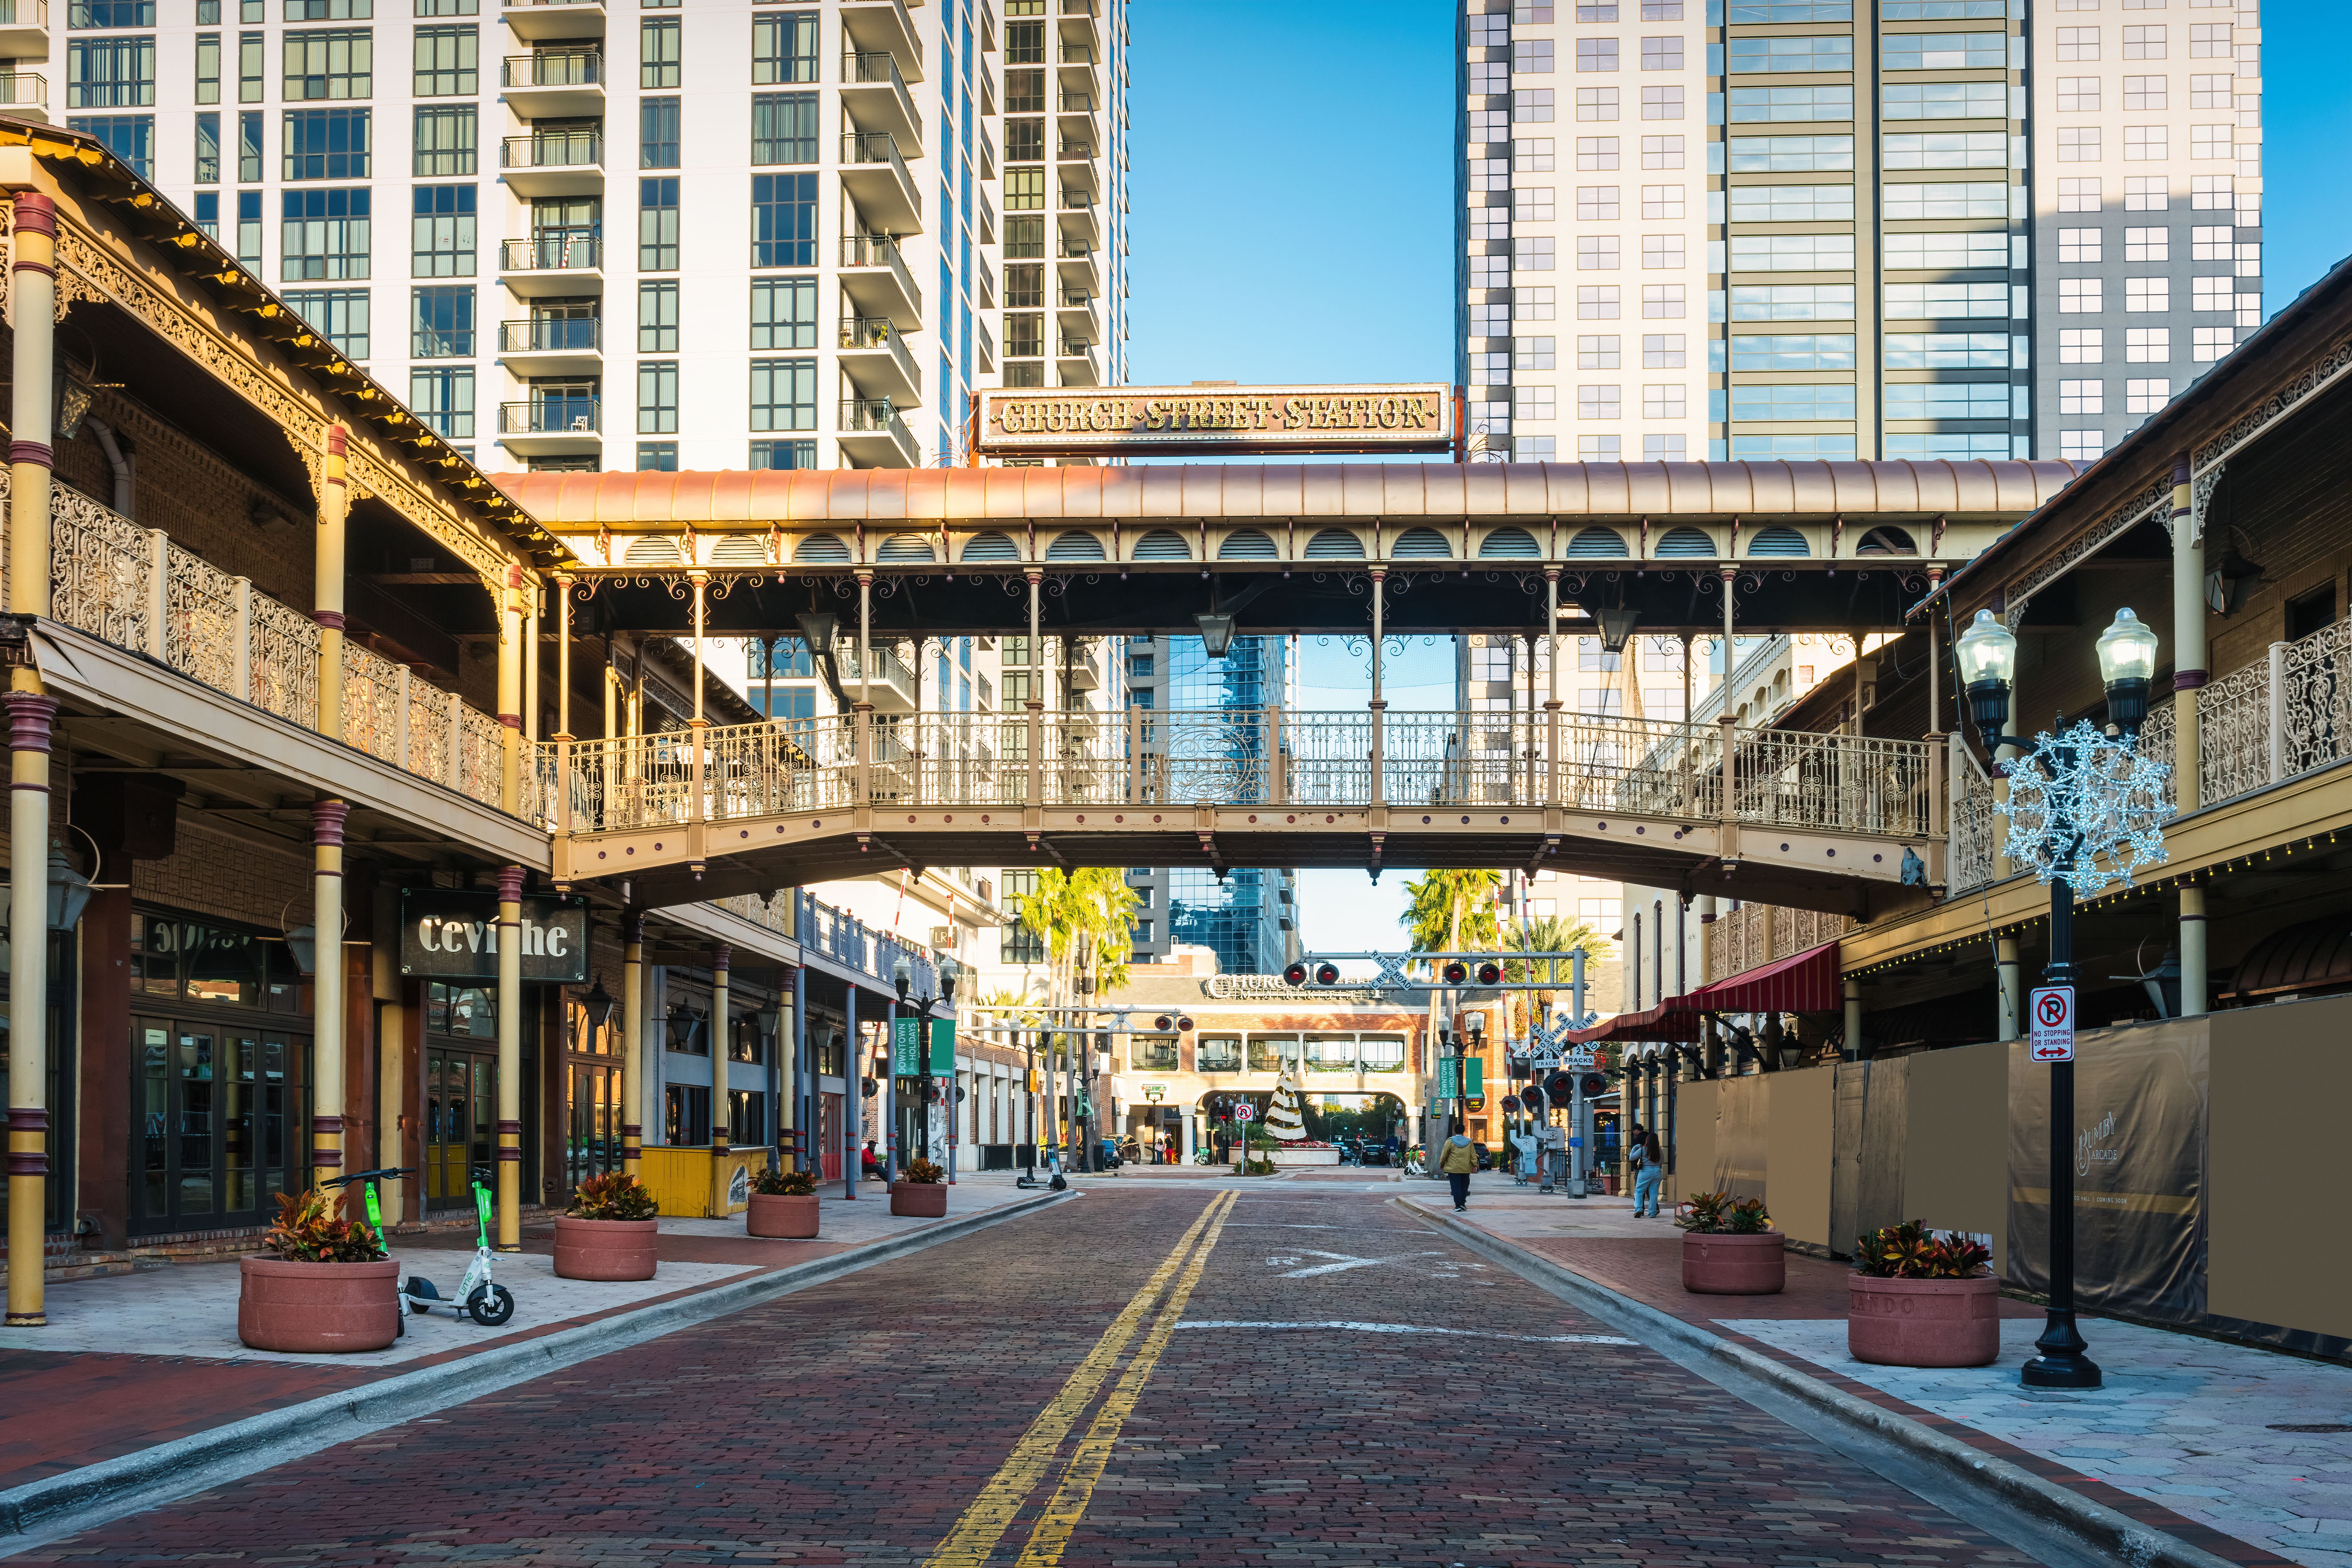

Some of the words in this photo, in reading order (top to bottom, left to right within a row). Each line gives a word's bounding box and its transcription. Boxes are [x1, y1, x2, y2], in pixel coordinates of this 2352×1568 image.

[1001, 400, 1133, 432] CHURCH
[1147, 399, 1272, 429] STREET
[1285, 396, 1428, 428] STATION
[419, 915, 568, 956] Cevíhe
[1209, 974, 1304, 999] CHURC
[1371, 951, 1388, 968] RAIL
[1393, 972, 1411, 988] ROAD
[1372, 952, 1411, 988] CROSSING
[1531, 1024, 1545, 1040] RAIL
[1531, 1025, 1565, 1055] CROSSING
[1556, 1013, 1574, 1030] RAIL
[1587, 1041, 1597, 1050] AD
[2075, 1111, 2116, 1176] BUMBY
[2091, 1150, 2117, 1160] ARCADE
[459, 1272, 473, 1296] Lime
